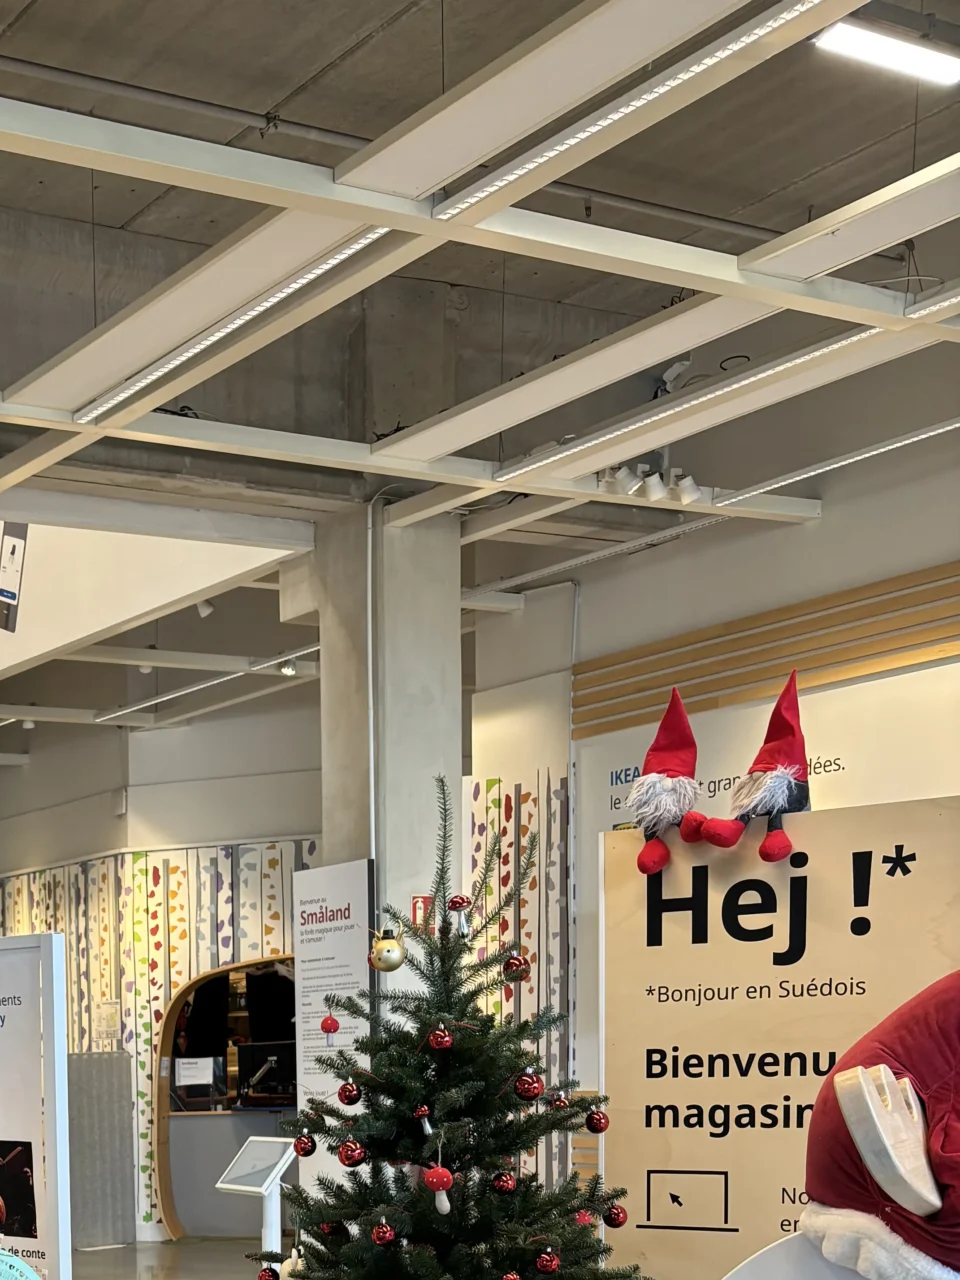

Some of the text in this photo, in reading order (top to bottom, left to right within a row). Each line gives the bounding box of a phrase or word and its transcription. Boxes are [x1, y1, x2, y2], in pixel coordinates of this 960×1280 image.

[610, 766, 641, 786] IKEA
[610, 794, 621, 810] le
[300, 902, 351, 926] Småland
[646, 851, 809, 966] Hej
[304, 928, 314, 936] forêt
[315, 926, 332, 938] magique
[334, 926, 343, 934] pour
[344, 924, 355, 932] jouer
[746, 985, 772, 1000] en
[778, 977, 866, 998] Suédois
[646, 1046, 837, 1079] Bienvenu
[21, 1248, 46, 1260] conte
